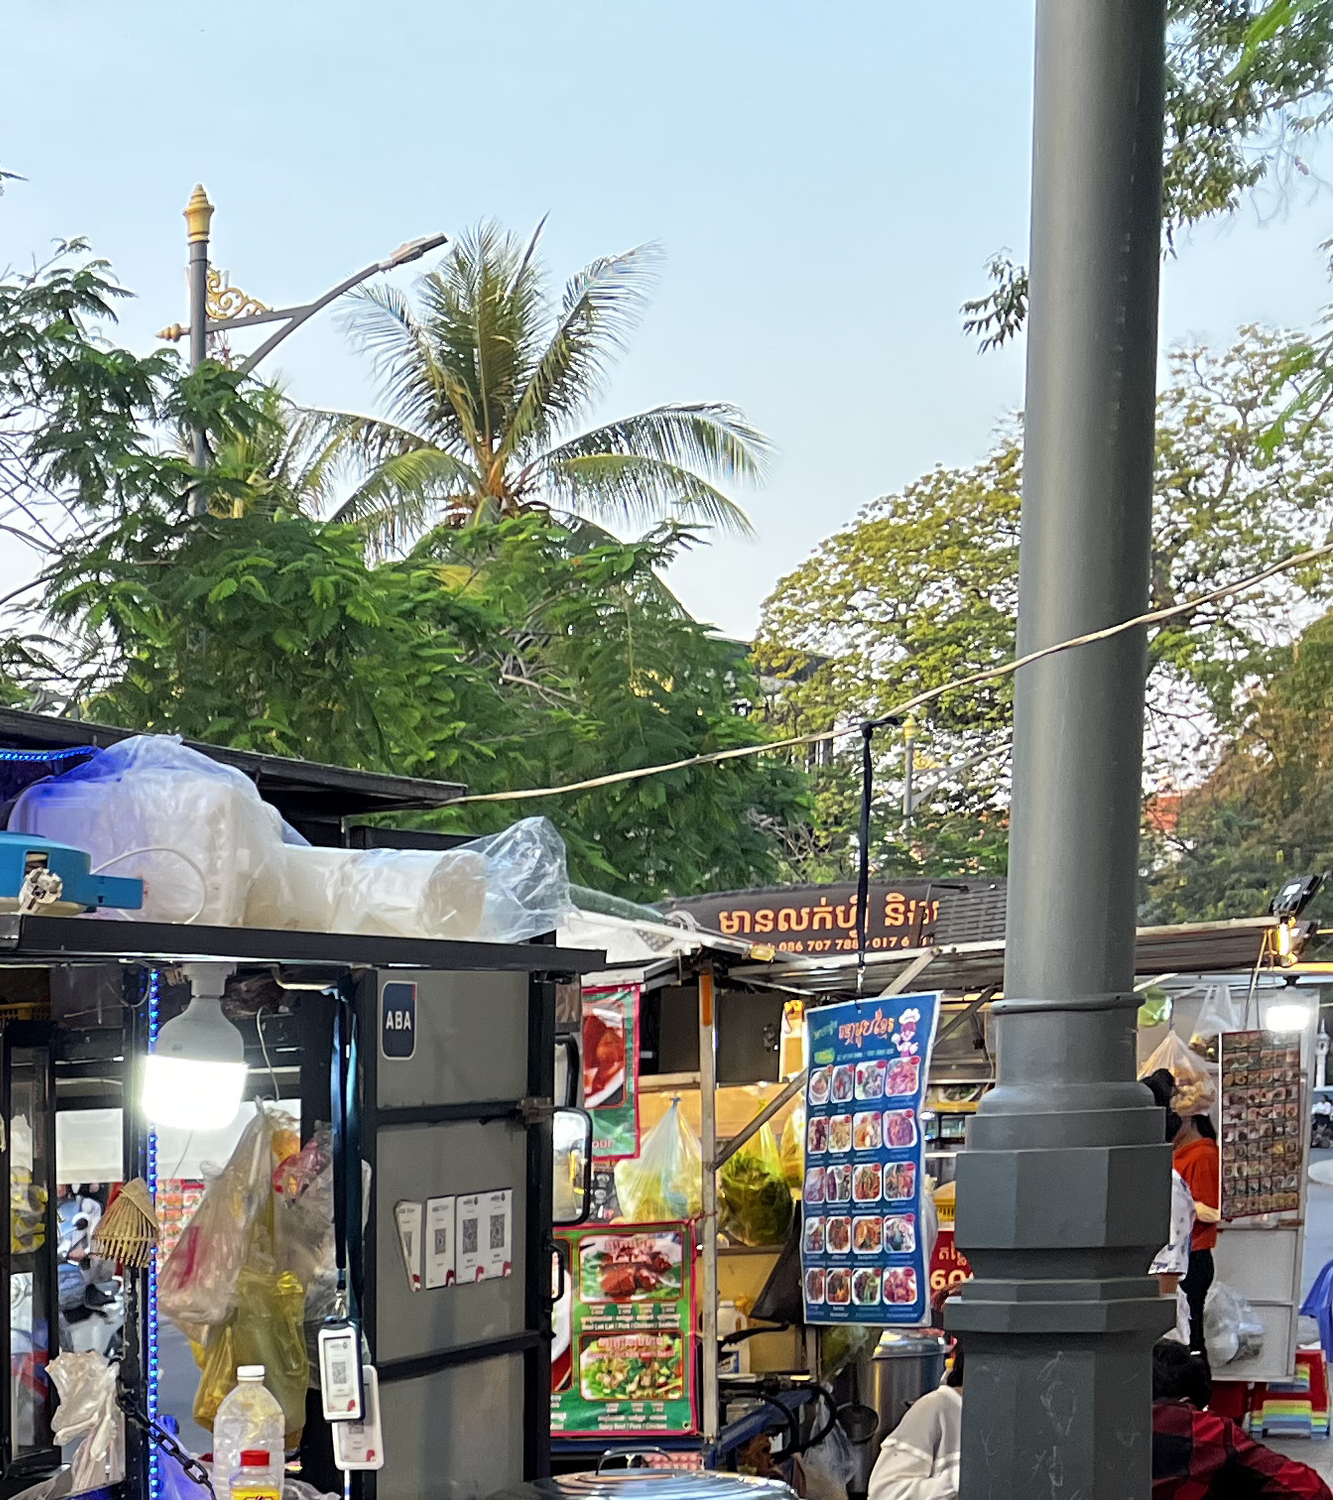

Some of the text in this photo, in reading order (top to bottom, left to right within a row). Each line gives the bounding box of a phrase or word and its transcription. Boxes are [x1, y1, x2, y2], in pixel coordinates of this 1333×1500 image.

[779, 940, 803, 952] 086
[807, 939, 831, 951] 707
[385, 1010, 412, 1031] ABA
